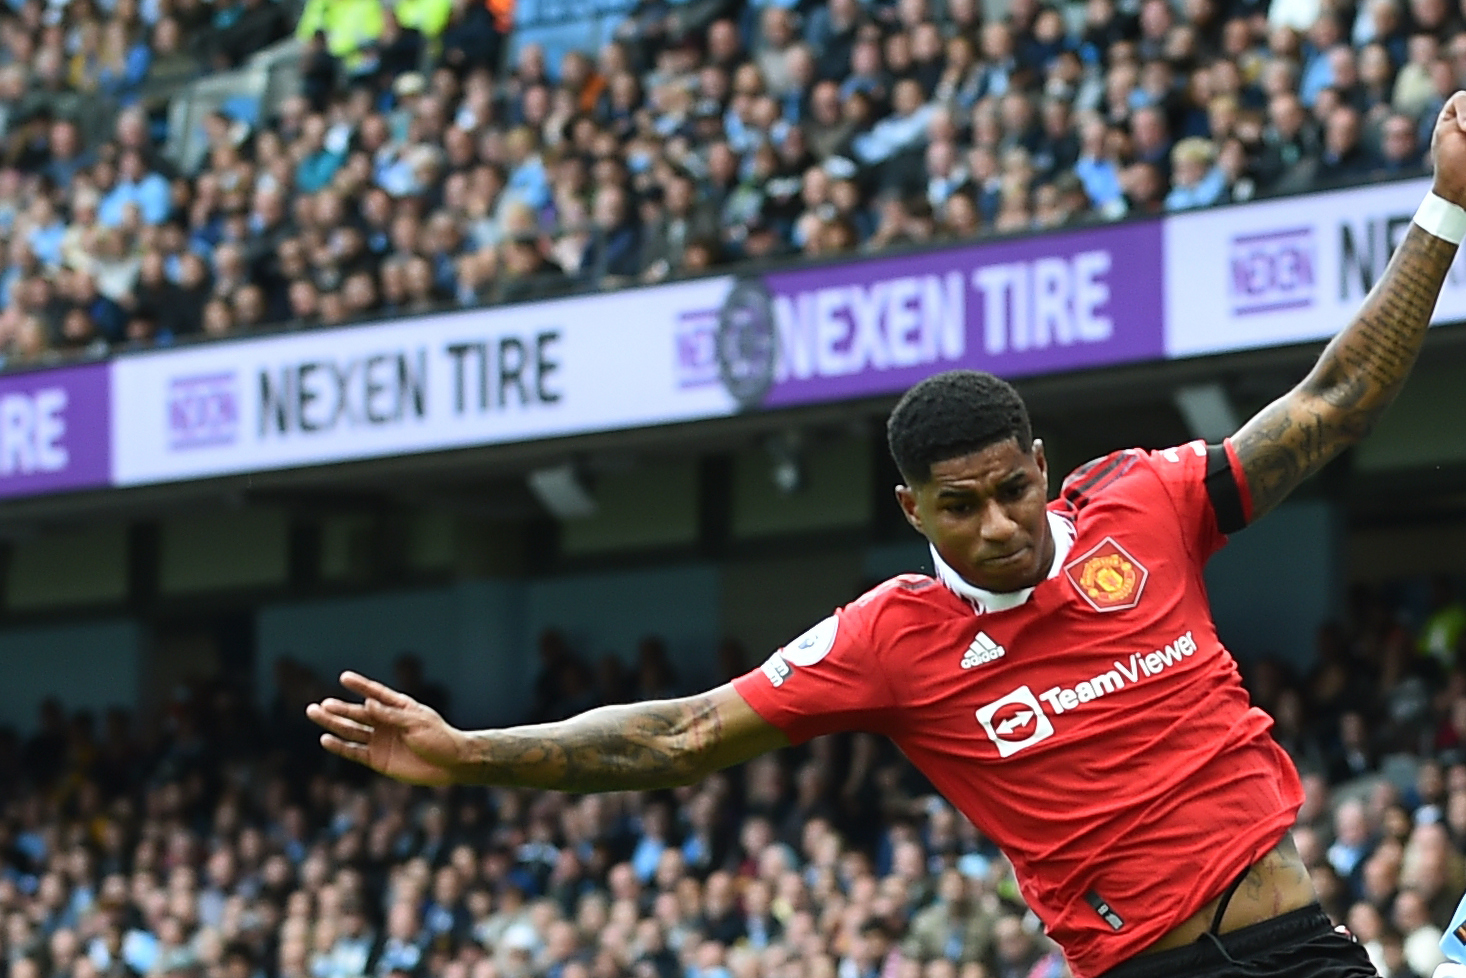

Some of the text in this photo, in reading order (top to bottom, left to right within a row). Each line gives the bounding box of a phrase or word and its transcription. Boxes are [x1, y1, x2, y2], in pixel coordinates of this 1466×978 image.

[777, 270, 966, 383] NEXEN
[971, 251, 1113, 354] TIRE
[258, 348, 428, 440] NEXEN
[447, 331, 564, 415] TIRE
[961, 645, 1006, 670] adidas
[1039, 631, 1198, 715] TeamViewer
